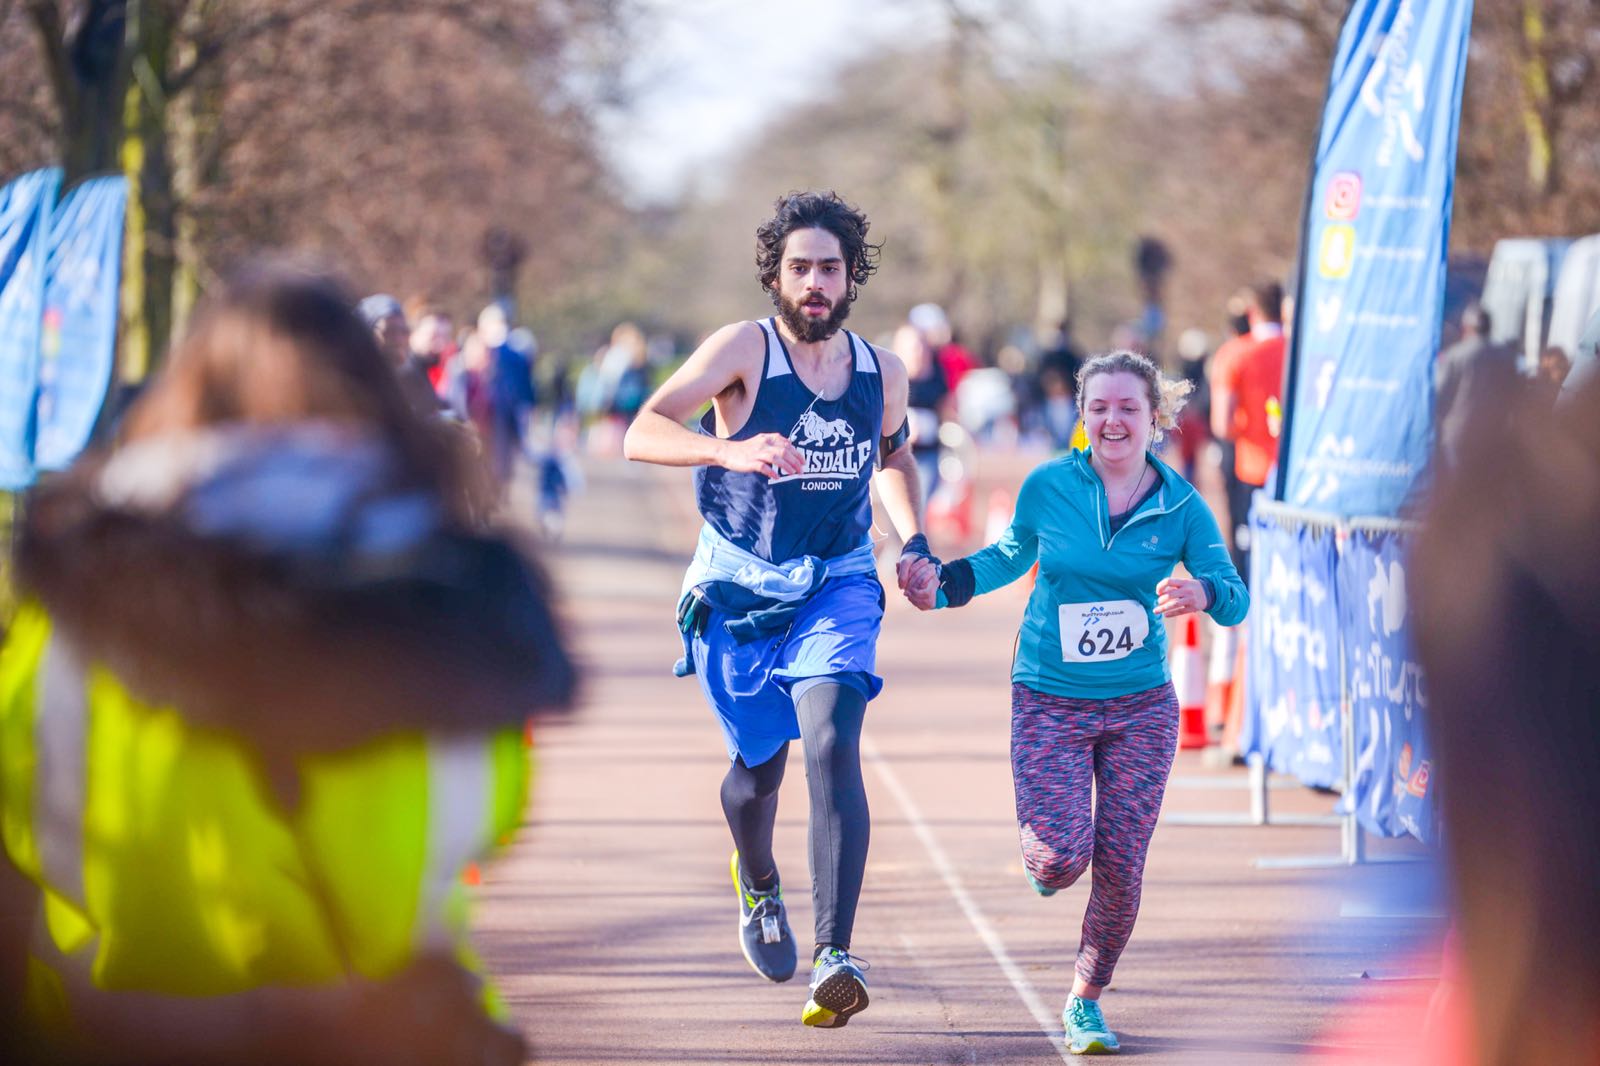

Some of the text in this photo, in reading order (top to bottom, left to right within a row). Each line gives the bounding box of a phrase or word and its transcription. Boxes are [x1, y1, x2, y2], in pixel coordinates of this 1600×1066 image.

[772, 440, 871, 475] NSDALE
[801, 481, 842, 491] LONDON
[1078, 626, 1134, 656] 624
